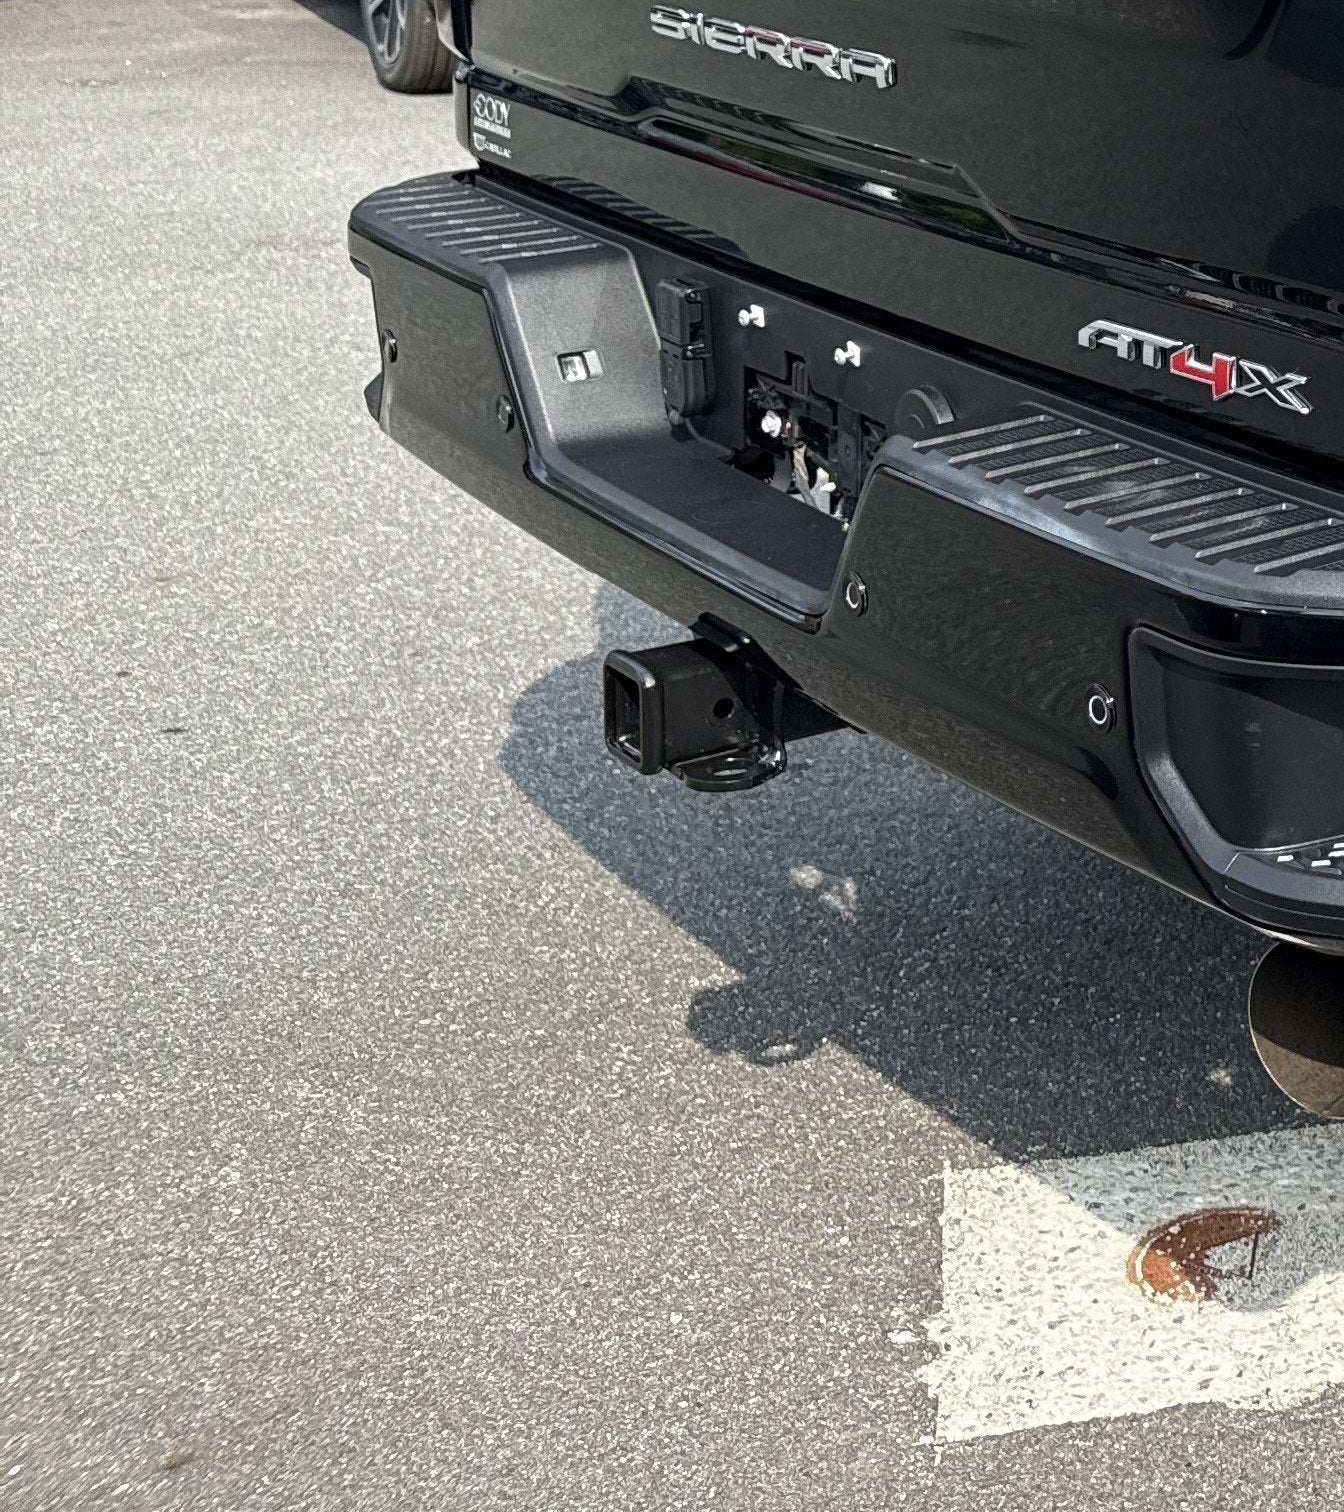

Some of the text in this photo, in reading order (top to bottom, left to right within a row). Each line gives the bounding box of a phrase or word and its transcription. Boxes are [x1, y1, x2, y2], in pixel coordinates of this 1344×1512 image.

[649, 3, 898, 90] SIERRA
[473, 92, 511, 127] CODY
[1078, 319, 1314, 414] AT4X
